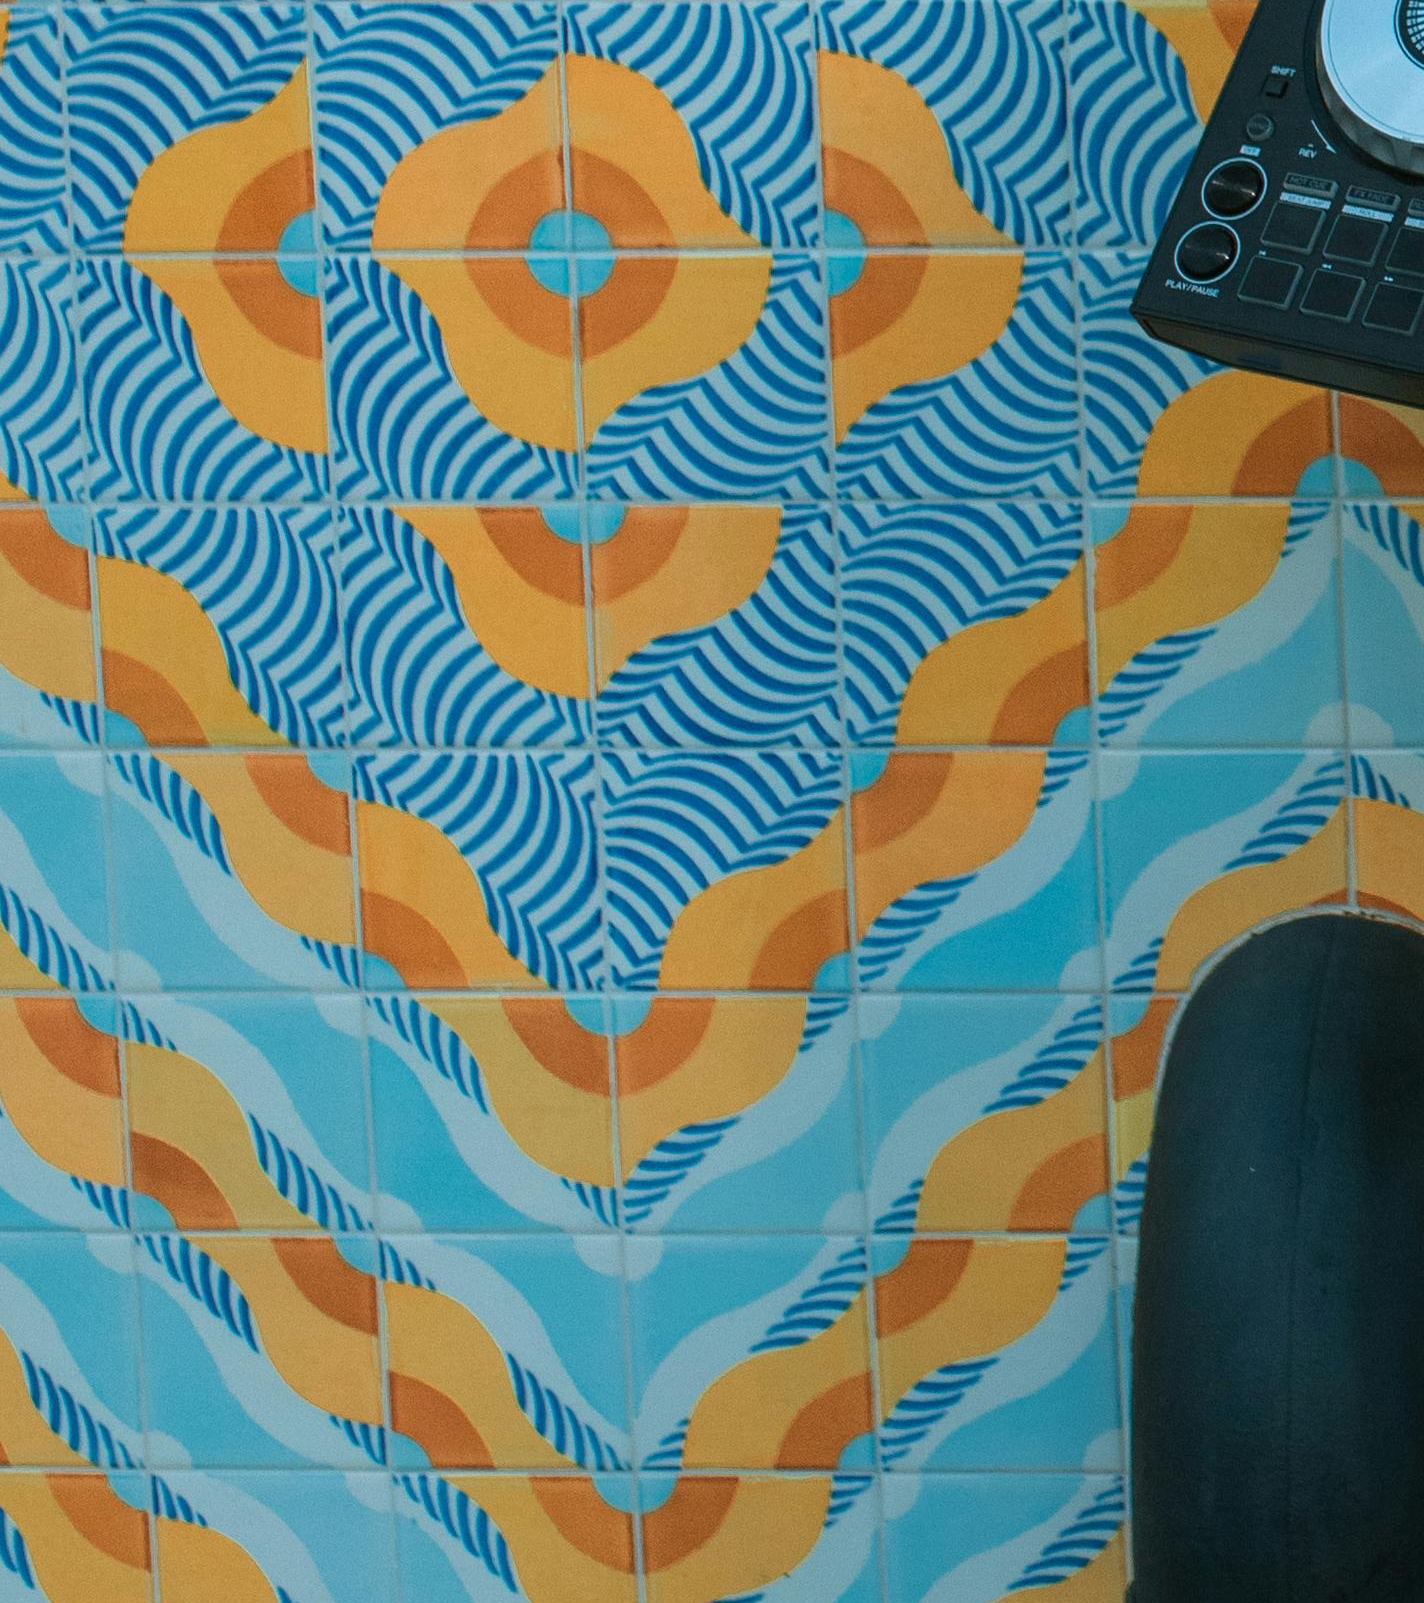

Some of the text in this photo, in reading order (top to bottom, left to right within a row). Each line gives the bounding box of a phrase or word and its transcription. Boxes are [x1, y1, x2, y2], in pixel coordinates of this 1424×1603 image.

[1271, 65, 1297, 77] SHIFT
[1298, 147, 1317, 158] REV
[1165, 279, 1220, 297] PLAY/PAUSE
